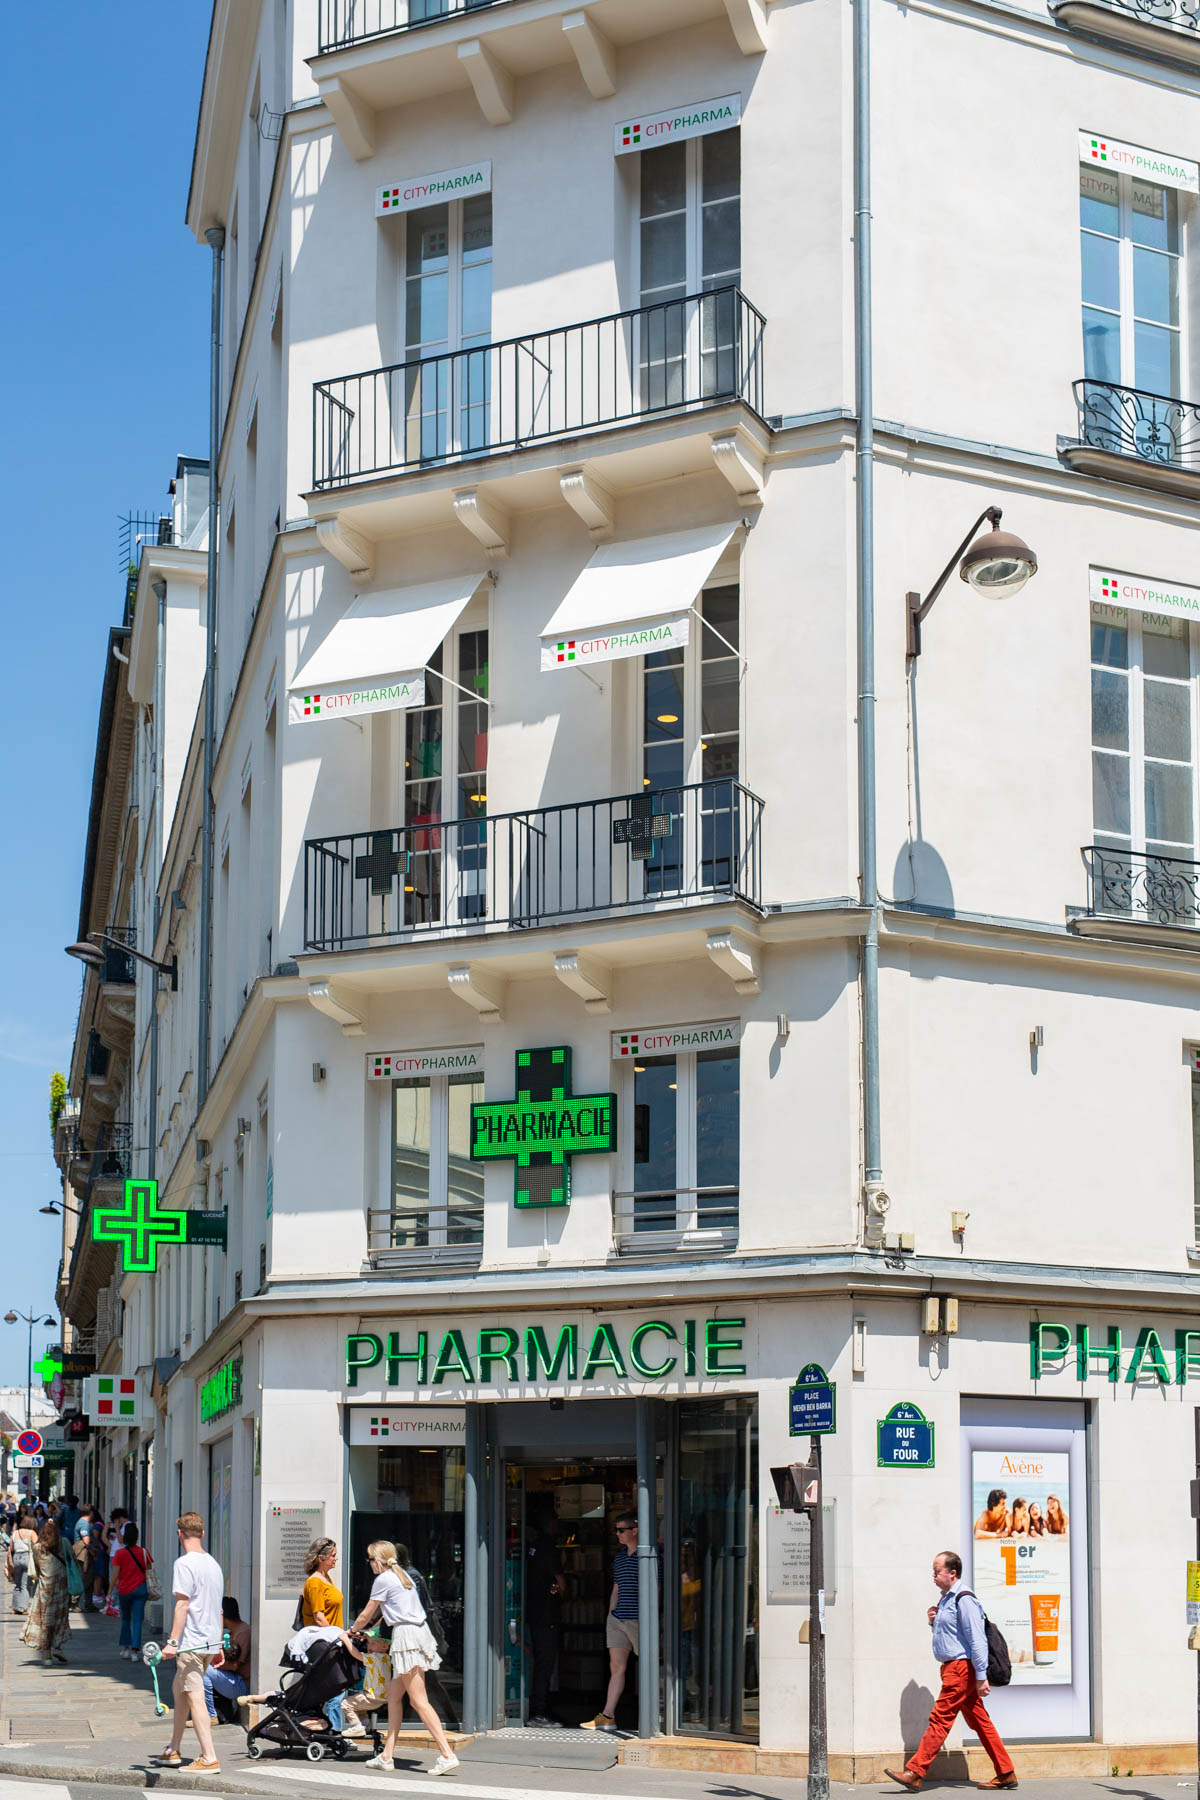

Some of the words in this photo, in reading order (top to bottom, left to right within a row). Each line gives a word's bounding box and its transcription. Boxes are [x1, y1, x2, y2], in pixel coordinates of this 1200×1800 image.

[646, 106, 733, 137] CITYPHARMA
[1111, 149, 1188, 180] CITYPHARMA
[403, 172, 484, 202] CITYPHARMA
[1122, 586, 1200, 610] CITYPHARMA
[581, 625, 672, 654] CITYPHARMA
[325, 684, 410, 709] CITYPHARMA
[643, 1028, 734, 1050] CITYPHARMA
[395, 1054, 477, 1072] CITYPHARMA
[473, 1106, 610, 1144] PHARMACIE
[346, 1318, 746, 1386] PHARMACIE
[804, 1392, 819, 1400] PLACE
[816, 1402, 831, 1410] BARKA
[896, 1428, 915, 1438] RUE
[893, 1449, 918, 1460] FOUR
[1000, 1456, 1043, 1474] Avène
